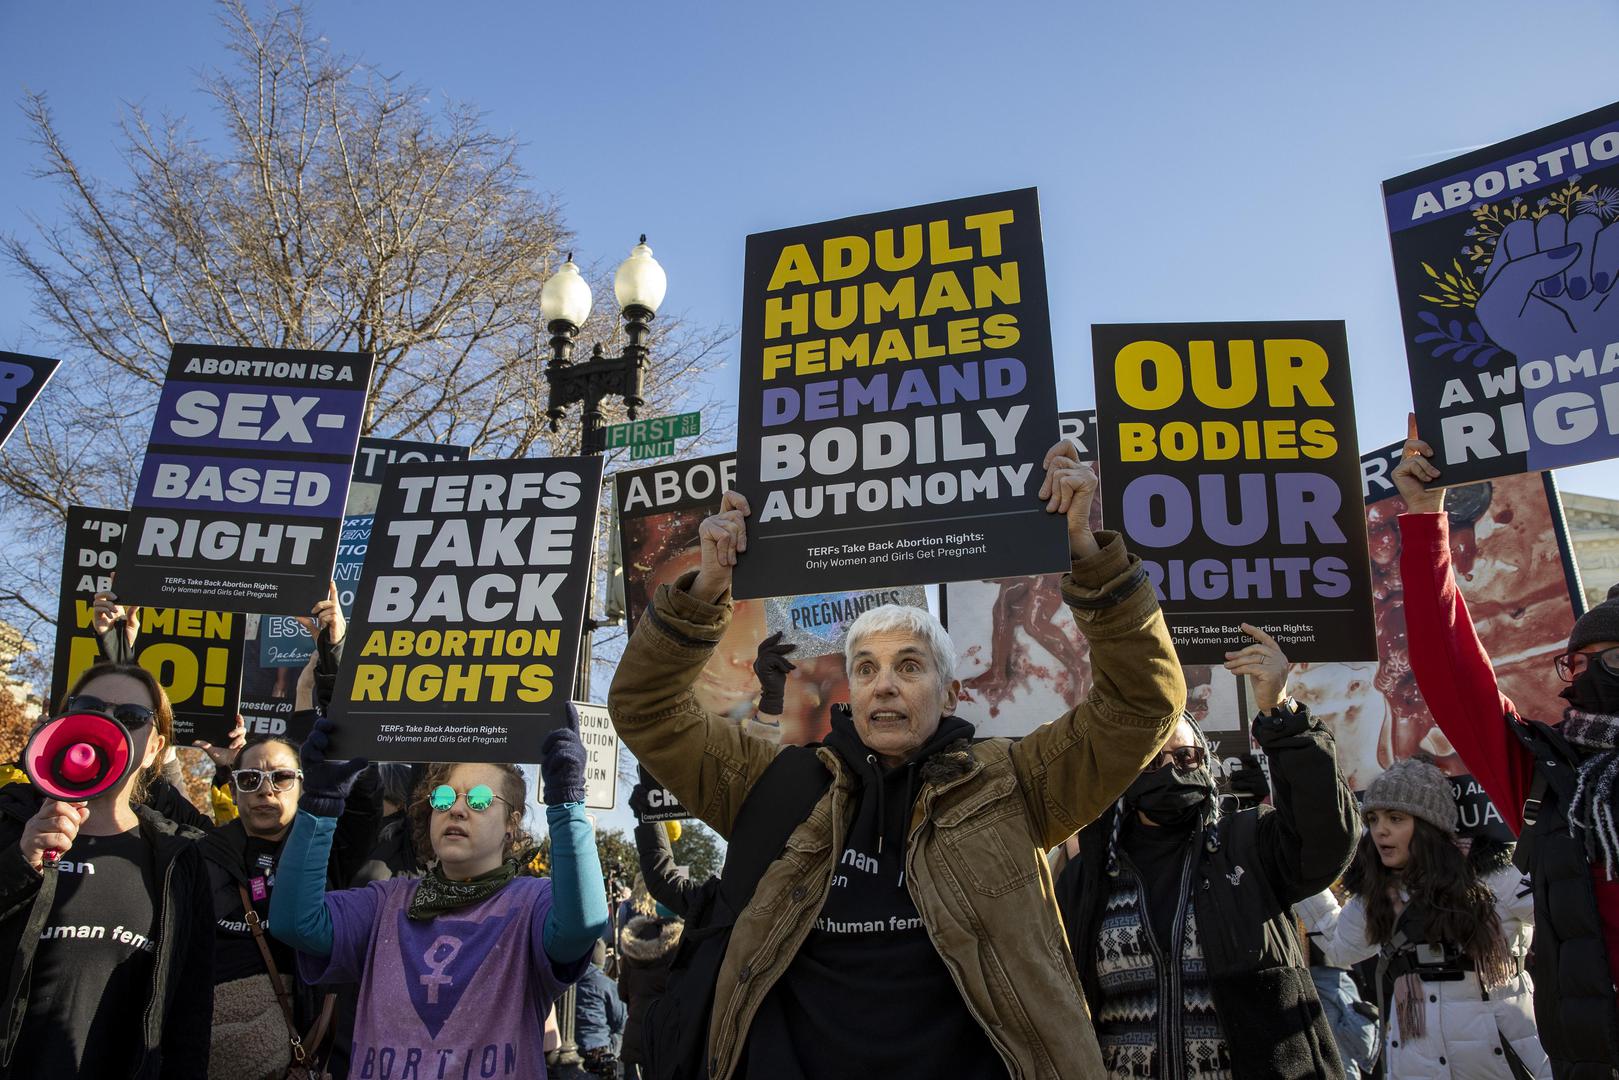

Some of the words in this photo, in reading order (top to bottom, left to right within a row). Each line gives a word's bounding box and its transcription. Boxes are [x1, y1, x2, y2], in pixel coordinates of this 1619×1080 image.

[767, 209, 1014, 291] ADULT
[764, 261, 1021, 340] HUMAN
[762, 313, 1021, 381] FEMALES
[184, 357, 306, 379] ABORTION
[309, 363, 334, 381] IS
[335, 366, 353, 381] A
[1114, 338, 1335, 411] OUR
[761, 357, 1028, 425] DEMAND
[1439, 378, 1474, 408] A
[170, 390, 346, 443] SEX-
[612, 418, 677, 447] FIRST
[682, 415, 696, 425] ST
[682, 424, 697, 434] NE
[632, 441, 673, 459] UNIT
[760, 404, 1030, 482] BODILY
[1118, 418, 1338, 462] BODIES
[152, 463, 331, 507] BASED
[398, 471, 582, 514] TERFS
[759, 463, 1034, 522] AUTONOMY
[1122, 472, 1348, 547] OUR
[137, 517, 324, 565] RIGHT
[387, 516, 577, 568] TAKE
[806, 559, 828, 570] Only
[830, 557, 867, 567] Women
[869, 553, 889, 563] and
[891, 551, 914, 562] Girls
[916, 549, 935, 559] Get
[937, 544, 986, 558] Pregnant
[808, 546, 840, 557] TERFs
[842, 544, 866, 554] Take
[868, 541, 894, 551] Back
[896, 536, 943, 549] Abortion
[945, 532, 985, 545] Rights:
[161, 585, 177, 593] Only
[177, 586, 202, 594] Women
[217, 588, 232, 596] Girls
[246, 590, 278, 599] Pregnant
[164, 577, 186, 585] TERFs
[187, 578, 203, 586] Take
[204, 579, 221, 587] Back
[221, 581, 252, 589] Abortion
[253, 582, 279, 591] Rights:
[367, 572, 568, 623] BACK
[360, 629, 561, 657] ABORTION
[1172, 626, 1199, 634] TERFs
[1200, 625, 1220, 634] Take
[1222, 625, 1242, 633] Back
[1283, 624, 1314, 634] Rights:
[1191, 637, 1222, 645] Women
[1223, 635, 1239, 644] and
[1277, 634, 1316, 644] Pregnant
[350, 664, 554, 703] RIGHTS
[377, 734, 394, 743] Only
[395, 735, 421, 743] Women
[423, 735, 438, 743] and
[439, 735, 456, 743] Girls
[457, 735, 471, 743] Get
[472, 735, 508, 745] Pregnant
[380, 725, 404, 733] TERFs
[405, 725, 422, 733] Take
[424, 725, 443, 733] Back
[444, 725, 478, 734] Abortion
[479, 725, 508, 735] Rights:
[827, 917, 885, 933] human
